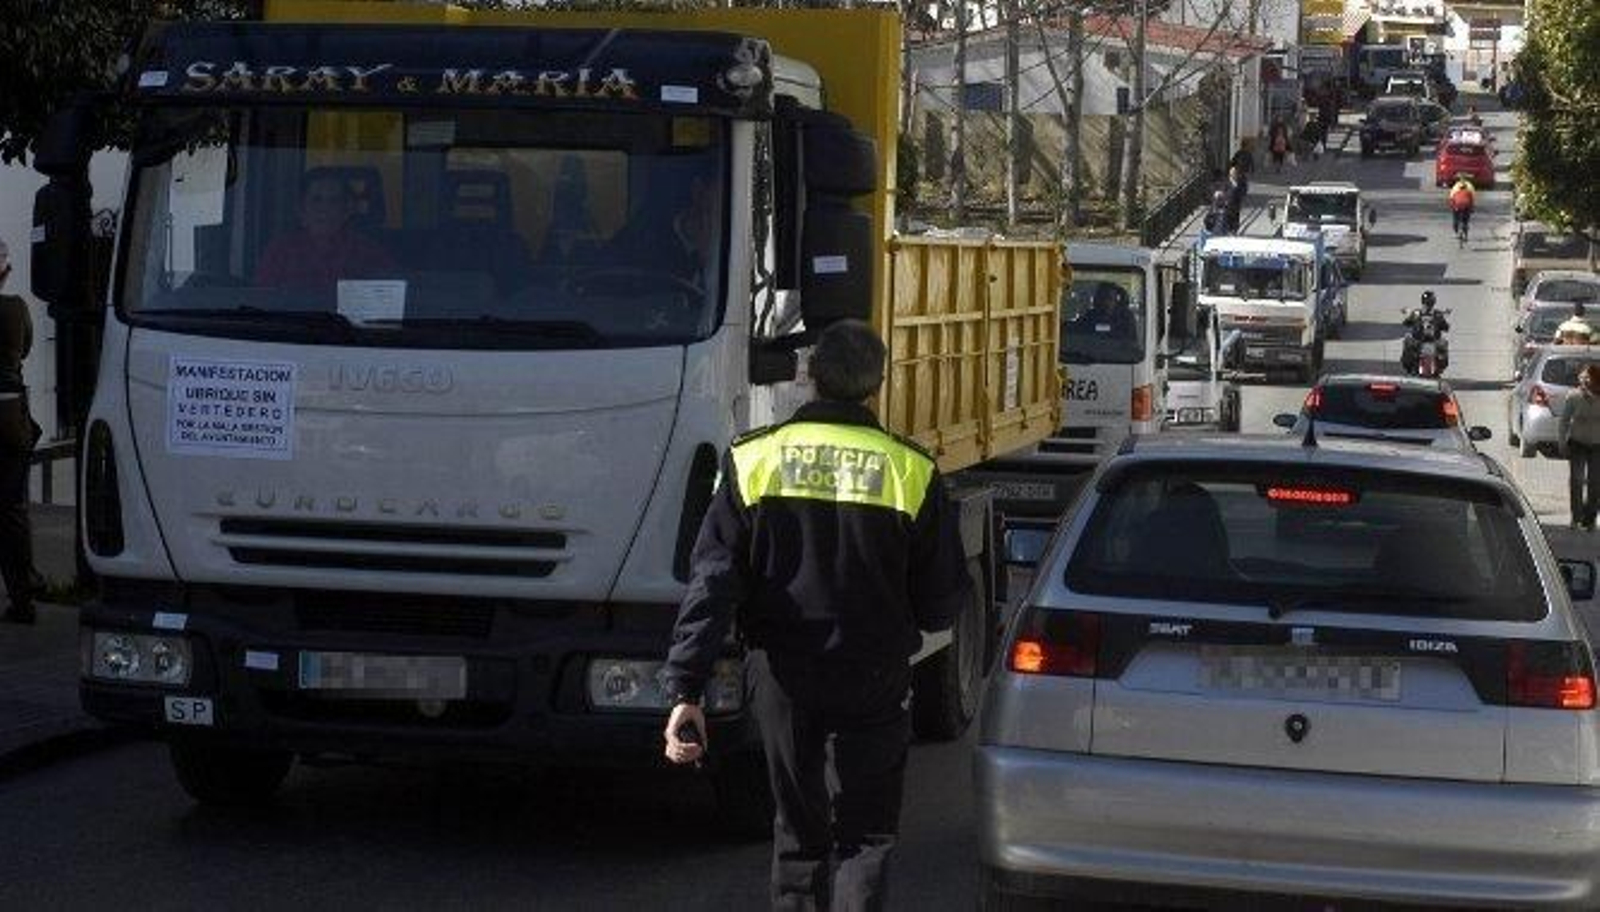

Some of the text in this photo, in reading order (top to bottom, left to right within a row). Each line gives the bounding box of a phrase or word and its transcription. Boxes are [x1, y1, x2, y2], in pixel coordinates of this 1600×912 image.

[182, 61, 394, 93] SARAY
[397, 75, 419, 94] &
[327, 363, 456, 395] IVECO
[185, 386, 276, 403] UBRIQUE SIN
[178, 402, 282, 420] VERTEDERO
[783, 446, 882, 471] POLICIA
[793, 467, 870, 491] LOCAL
[216, 487, 567, 521] EUROCARGO
[1149, 622, 1193, 636] SEAT
[1408, 639, 1459, 653] IBIZA
